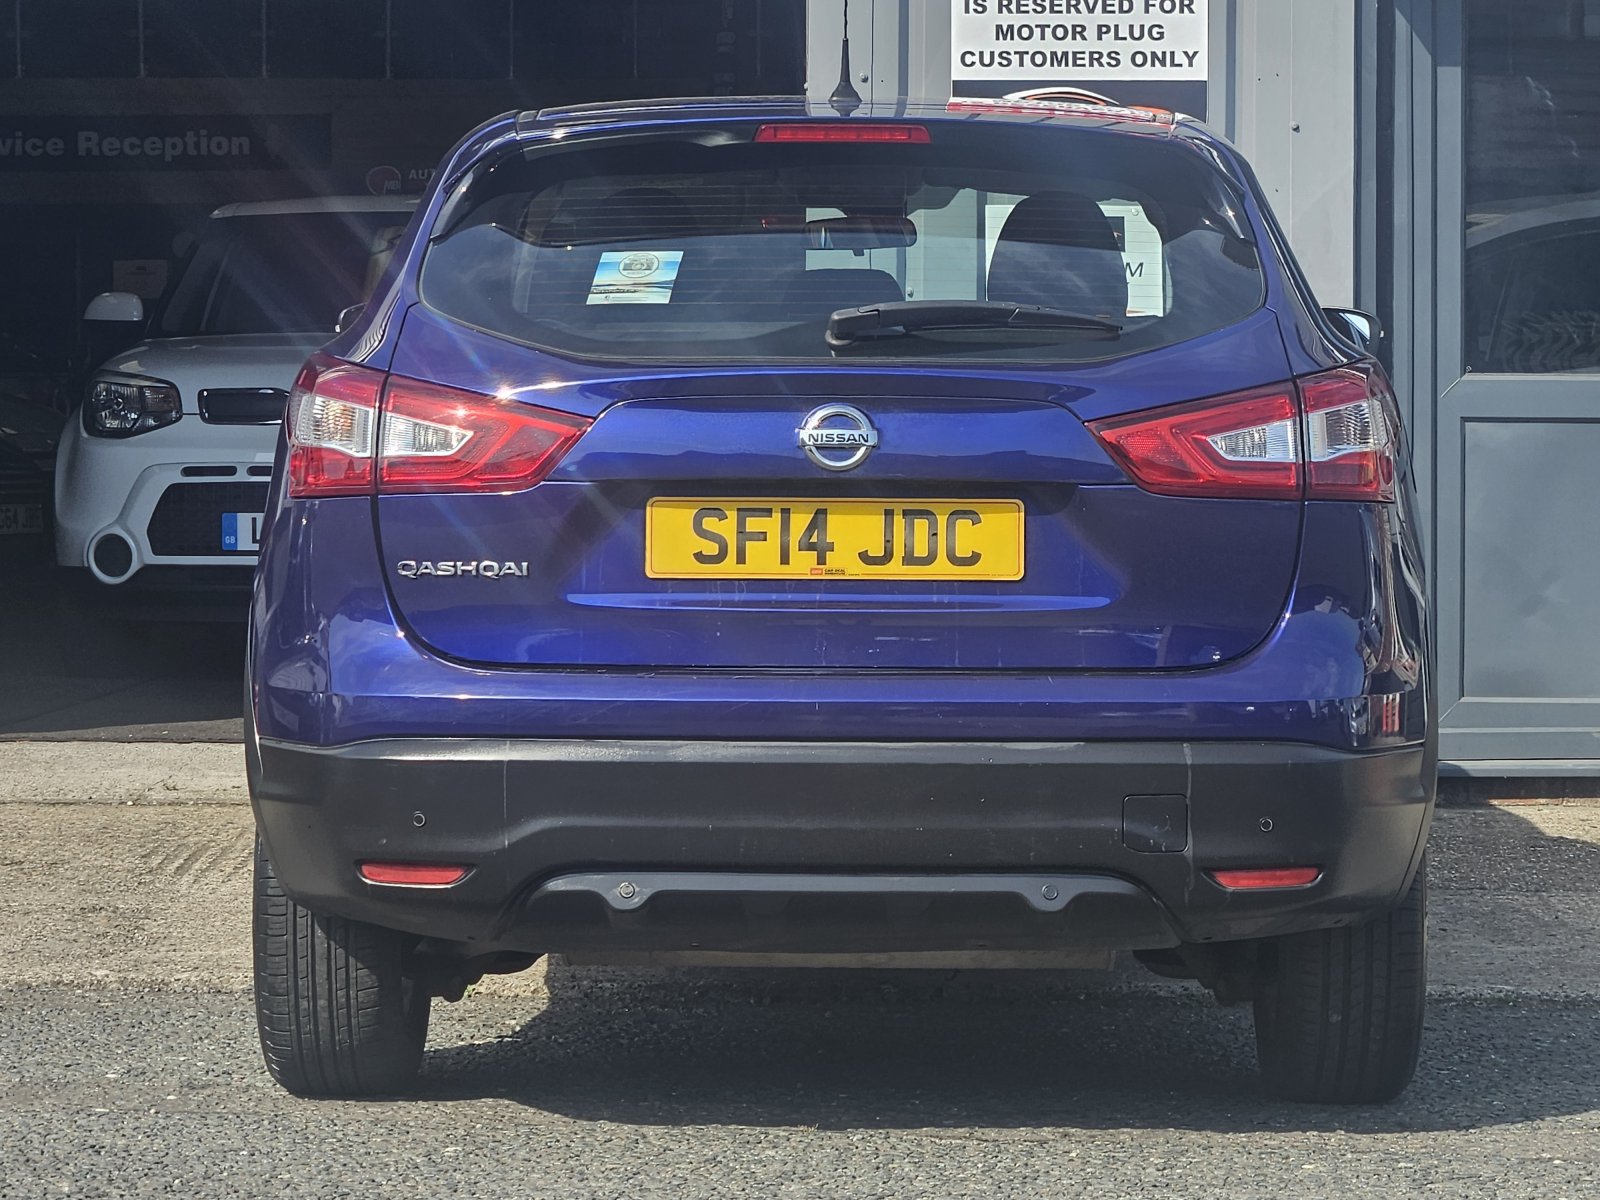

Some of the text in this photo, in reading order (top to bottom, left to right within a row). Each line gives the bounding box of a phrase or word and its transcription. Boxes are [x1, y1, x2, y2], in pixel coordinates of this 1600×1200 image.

[964, 0, 1196, 14] IS RESERVED FOR
[995, 24, 1166, 41] MOTOR PLUG
[960, 50, 1200, 68] CUSTOMERS ONLY
[77, 129, 251, 161] Reception
[808, 433, 869, 443] NISSAN
[225, 535, 236, 544] GB
[692, 507, 982, 567] SF14 JDC
[397, 560, 529, 579] QASHQAI
